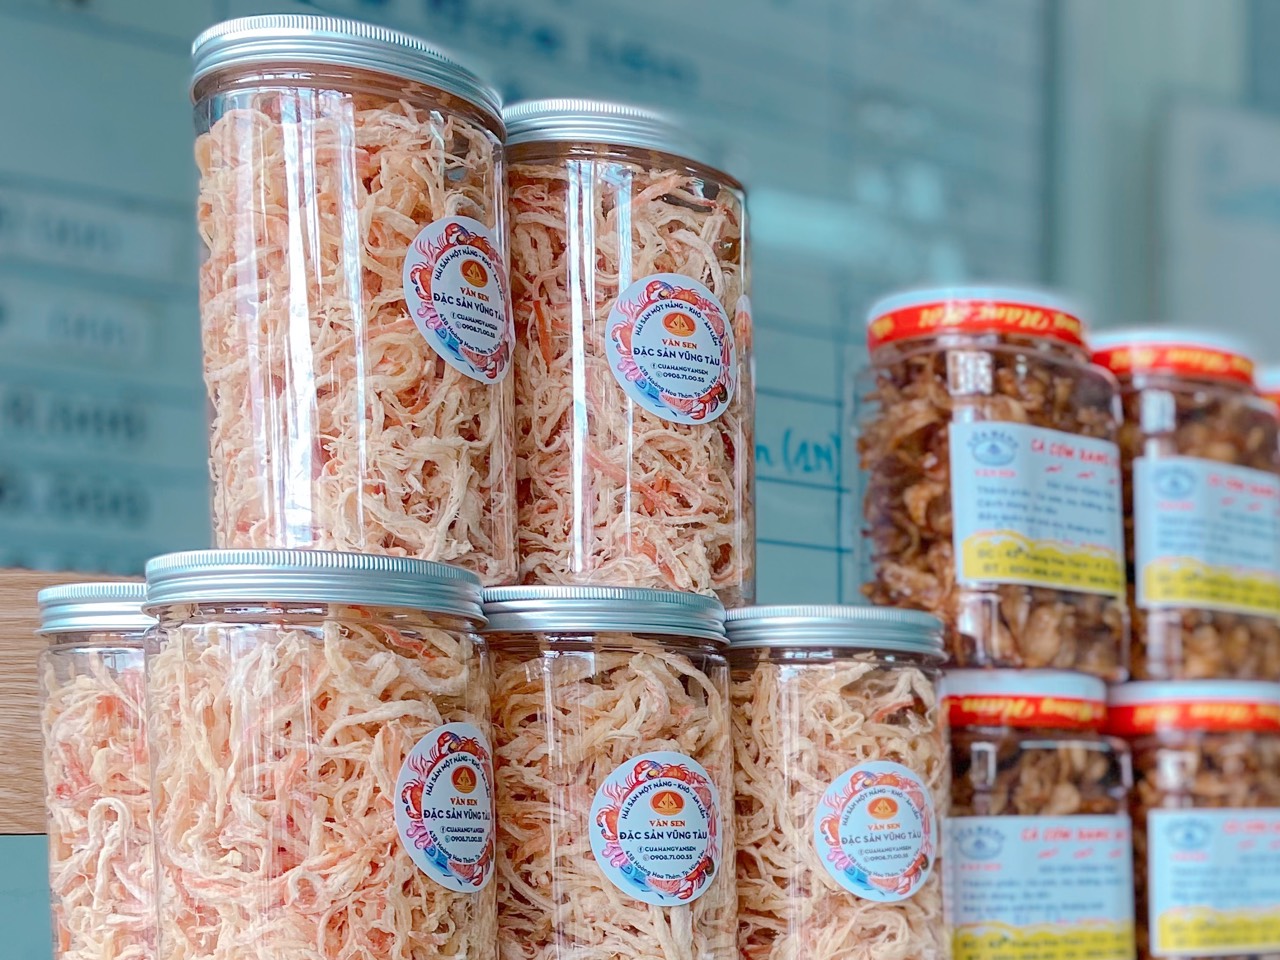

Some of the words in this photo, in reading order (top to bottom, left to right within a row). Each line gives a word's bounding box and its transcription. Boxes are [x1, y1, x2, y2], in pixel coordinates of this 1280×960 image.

[683, 341, 697, 349] SEN
[634, 348, 654, 357] ĐẶC
[657, 347, 676, 359] SẢN
[679, 350, 703, 362] VŨNG
[705, 355, 720, 366] TÀU
[619, 830, 642, 842] ĐẶC
[644, 829, 664, 840] SẢN
[665, 830, 691, 840] VŨNG
[692, 830, 708, 839] TÀU
